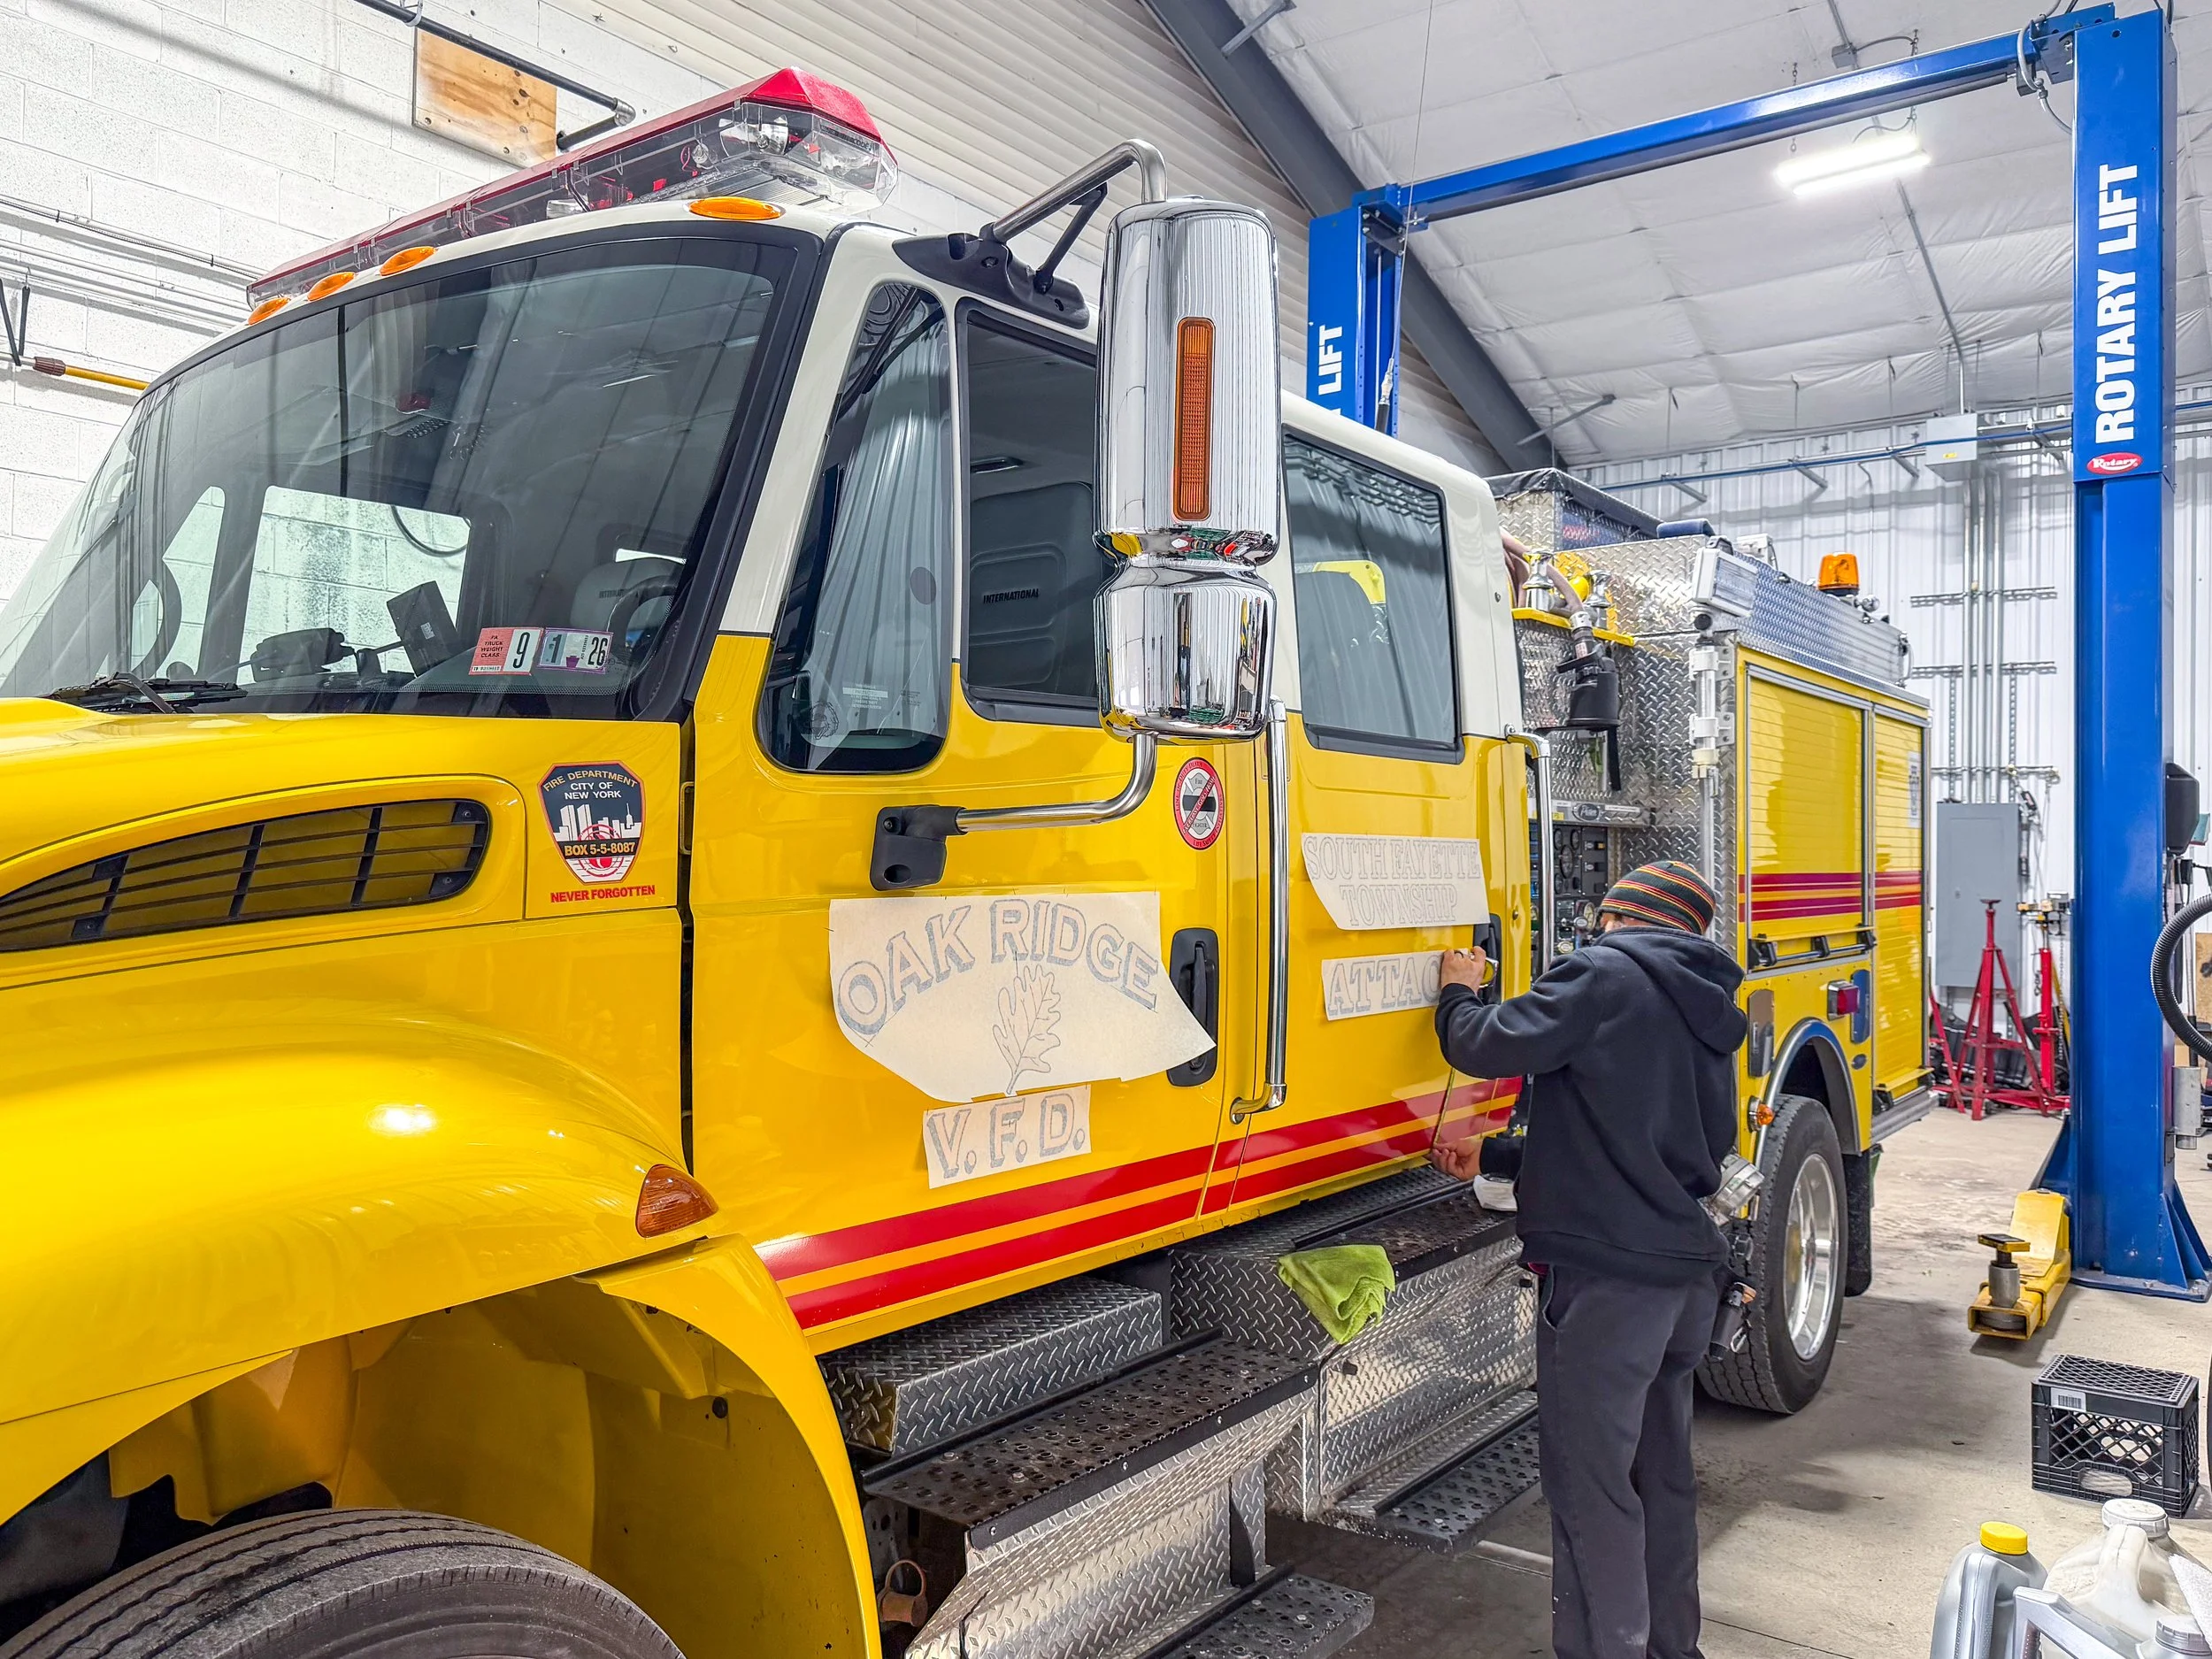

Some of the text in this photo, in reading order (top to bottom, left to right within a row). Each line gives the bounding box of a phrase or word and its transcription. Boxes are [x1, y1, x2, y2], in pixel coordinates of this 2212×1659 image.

[2095, 164, 2138, 444] ROTARY LIFT
[1317, 325, 1342, 396] LIFT
[2093, 457, 2138, 471] Rotary
[983, 588, 1039, 603] INTERNATIONAL
[512, 632, 531, 669] 9
[550, 634, 563, 664] 1
[588, 637, 608, 666] 26
[542, 771, 638, 792] FIRE DEPARTMENT
[570, 782, 595, 791] CITY
[565, 842, 635, 856] BOX 5-5-8087
[1303, 836, 1481, 880] SOUTH FAYETTE
[550, 885, 656, 902] NEVER FORGOTTEN
[1339, 883, 1458, 926] TOWNSHIP
[837, 899, 1159, 1035] OAK RIDGE
[1327, 954, 1442, 1016] ATTAC
